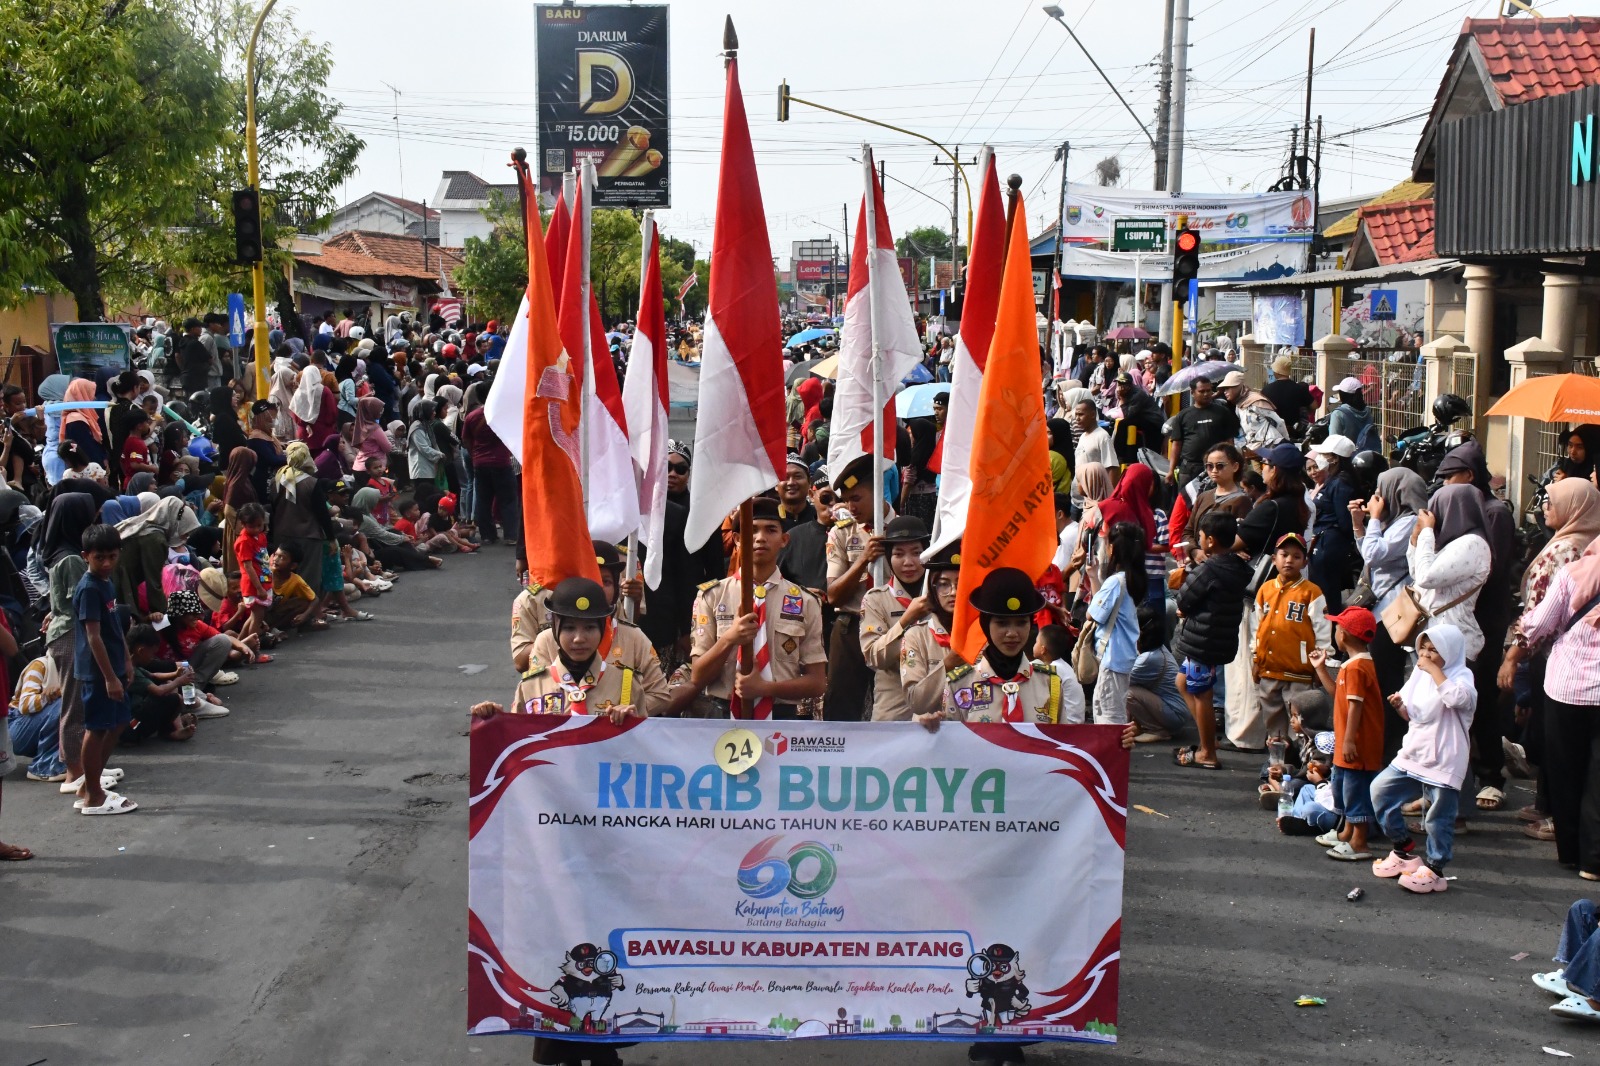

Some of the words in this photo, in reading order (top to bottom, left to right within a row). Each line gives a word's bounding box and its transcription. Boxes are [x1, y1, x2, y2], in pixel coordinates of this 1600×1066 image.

[545, 9, 581, 19] BARU
[578, 31, 628, 43] DJARUM
[576, 48, 635, 116] D
[568, 125, 619, 142] 15.000
[1571, 114, 1600, 186] N
[800, 265, 821, 273] Leno
[1285, 600, 1305, 622] H
[791, 736, 846, 746] BAWASLU
[724, 738, 754, 764] 24
[596, 761, 762, 811] KIRAB
[778, 764, 1006, 814] BUDAYA
[538, 812, 597, 827] DALAM
[602, 815, 671, 828] RANGKA
[675, 815, 715, 829] HARI
[720, 817, 776, 831] ULANG
[780, 818, 836, 831] TAHUN
[841, 818, 888, 831] KE-60
[892, 819, 991, 832] KABUPATEN
[995, 820, 1060, 832] BATANG
[737, 834, 838, 900] 60
[829, 843, 843, 852] Th
[735, 896, 798, 919] Kabupaten
[801, 897, 845, 922] Batang
[746, 918, 783, 928] Batang
[785, 918, 827, 928] Bahagia
[627, 939, 735, 957] BAWASLU
[741, 941, 870, 957] KABUPATEN
[876, 941, 964, 957] BATANG
[635, 982, 672, 995] Bersama
[673, 980, 706, 997] Rakyat
[707, 981, 734, 993] Awasi
[735, 979, 765, 993] Pemilu,
[767, 981, 803, 993] Bersama
[805, 980, 844, 993] Bawaslu
[845, 981, 885, 996] Tegakkan
[886, 981, 924, 994] Keadilan
[926, 982, 954, 995] Pemilu
